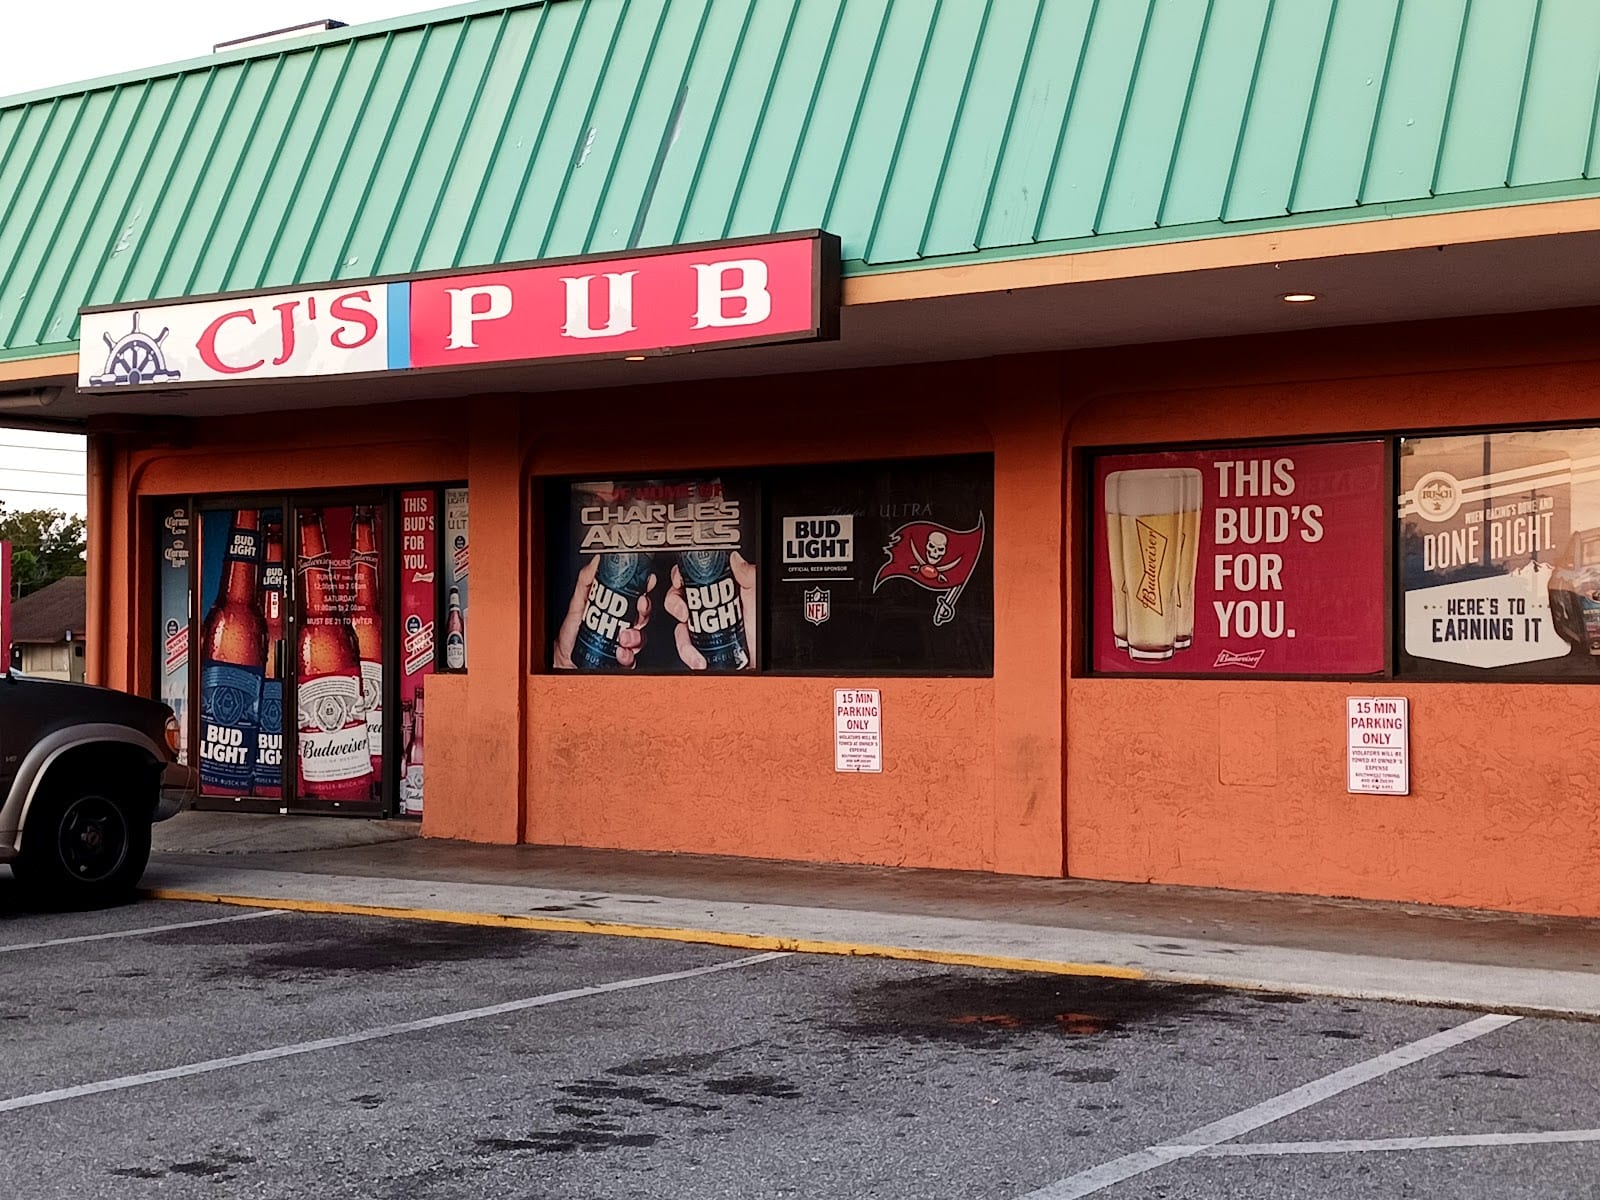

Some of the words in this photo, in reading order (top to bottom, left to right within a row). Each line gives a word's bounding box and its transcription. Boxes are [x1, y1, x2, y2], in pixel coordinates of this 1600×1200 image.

[196, 290, 378, 374] CJ'S
[1213, 458, 1296, 498] THIS
[1422, 489, 1453, 499] BUSCH
[403, 497, 428, 513] THIS
[580, 500, 740, 525] CHARLIE'S
[880, 503, 933, 518] ULTRA
[403, 515, 434, 532] BUD'S
[580, 518, 741, 548] ANGELS
[795, 520, 841, 539] BUD
[1214, 504, 1324, 545] BUD'S
[233, 534, 255, 546] BUD
[403, 535, 425, 550] FOR
[786, 539, 850, 559] LIGHT
[1423, 526, 1479, 572] DONE
[1490, 512, 1557, 560] RIGHT.
[229, 545, 257, 557] LIGHT
[403, 553, 428, 569] YOU.
[1141, 531, 1158, 609] Budweiser
[266, 567, 284, 577] BUD
[1214, 553, 1283, 591] FOR
[588, 578, 629, 618] BUD
[685, 577, 736, 610] BUD
[808, 602, 827, 619] NFL
[1447, 597, 1499, 616] HERE'S
[1507, 598, 1526, 615] TO
[1213, 600, 1296, 639] YOU.
[1432, 618, 1514, 643] EARNING
[1524, 618, 1542, 643] IT
[842, 693, 854, 704] 15
[855, 693, 873, 704] MIN
[1357, 702, 1371, 714] 15
[1374, 702, 1397, 714] MIN
[837, 706, 878, 717] PARKING
[846, 719, 870, 730] ONLY
[1351, 717, 1403, 729] PARKING
[206, 724, 244, 747] BUD
[1362, 733, 1392, 745] ONLY
[200, 740, 249, 765] LIGHT
[303, 738, 368, 760] Budweiser
